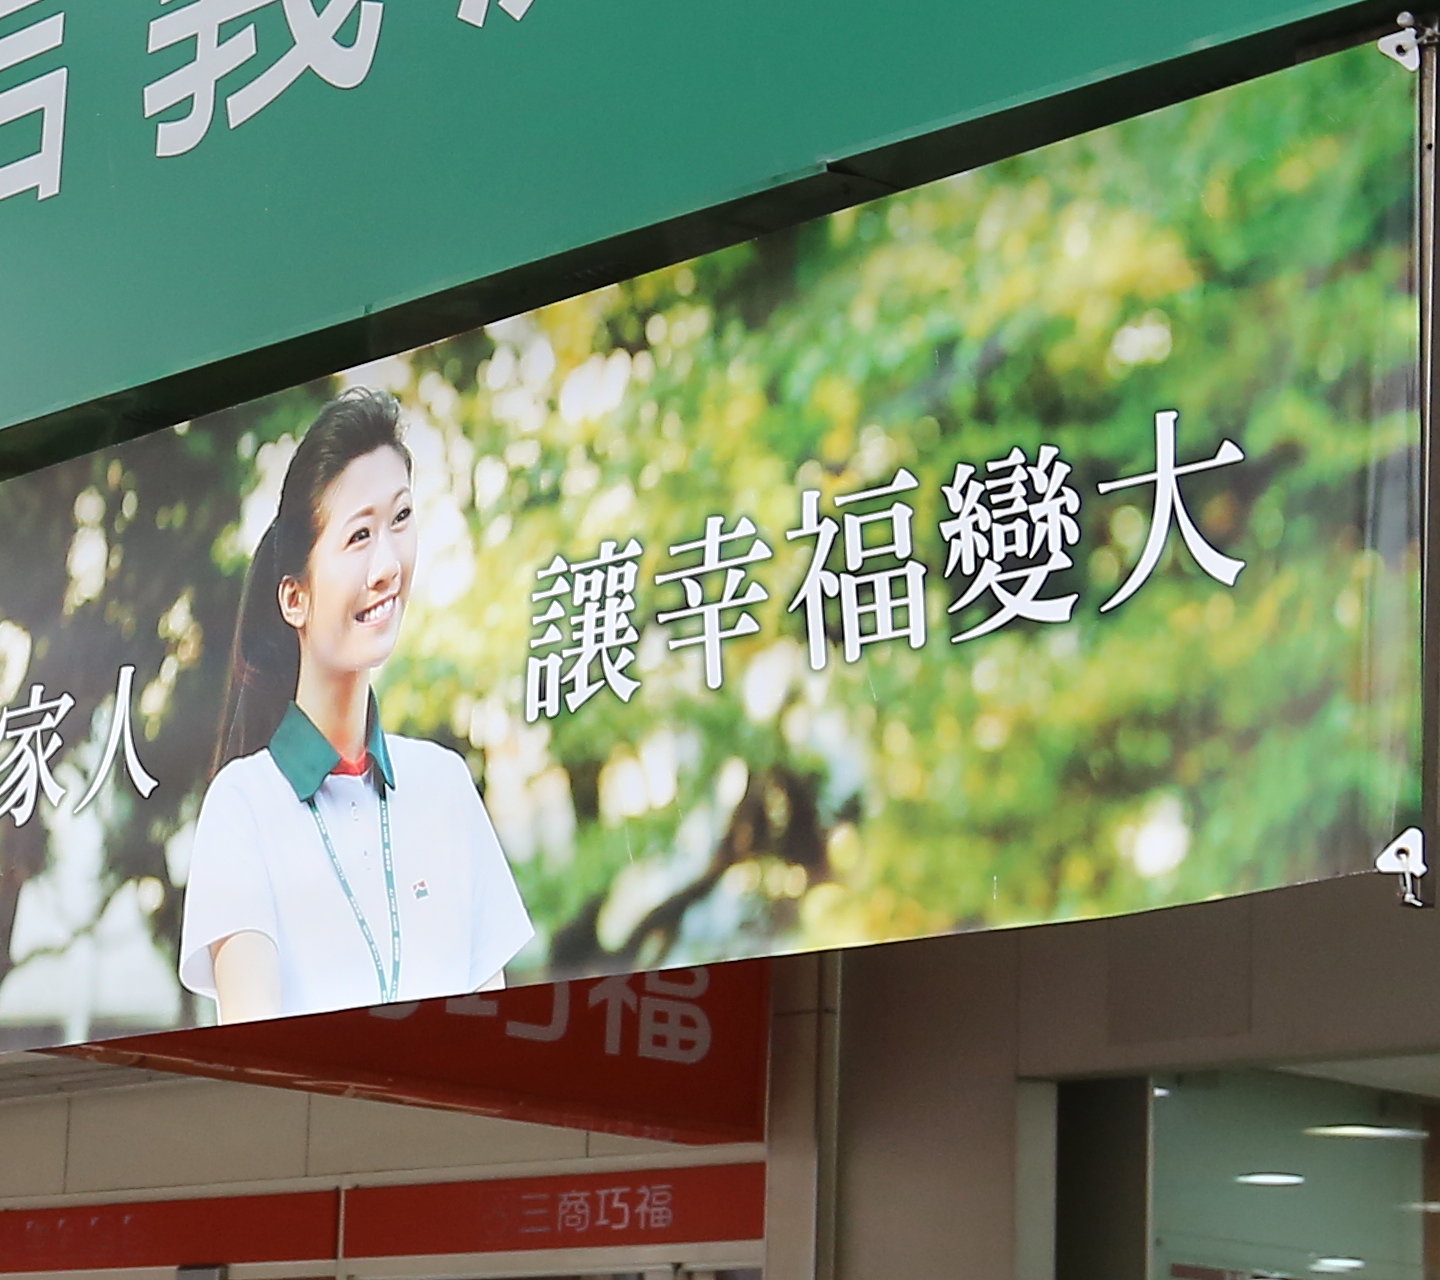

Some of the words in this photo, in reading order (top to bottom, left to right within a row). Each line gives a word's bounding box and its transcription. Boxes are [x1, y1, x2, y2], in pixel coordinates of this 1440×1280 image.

[525, 406, 1248, 723] 讓幸福變大
[520, 1185, 673, 1235] 三商巧福
